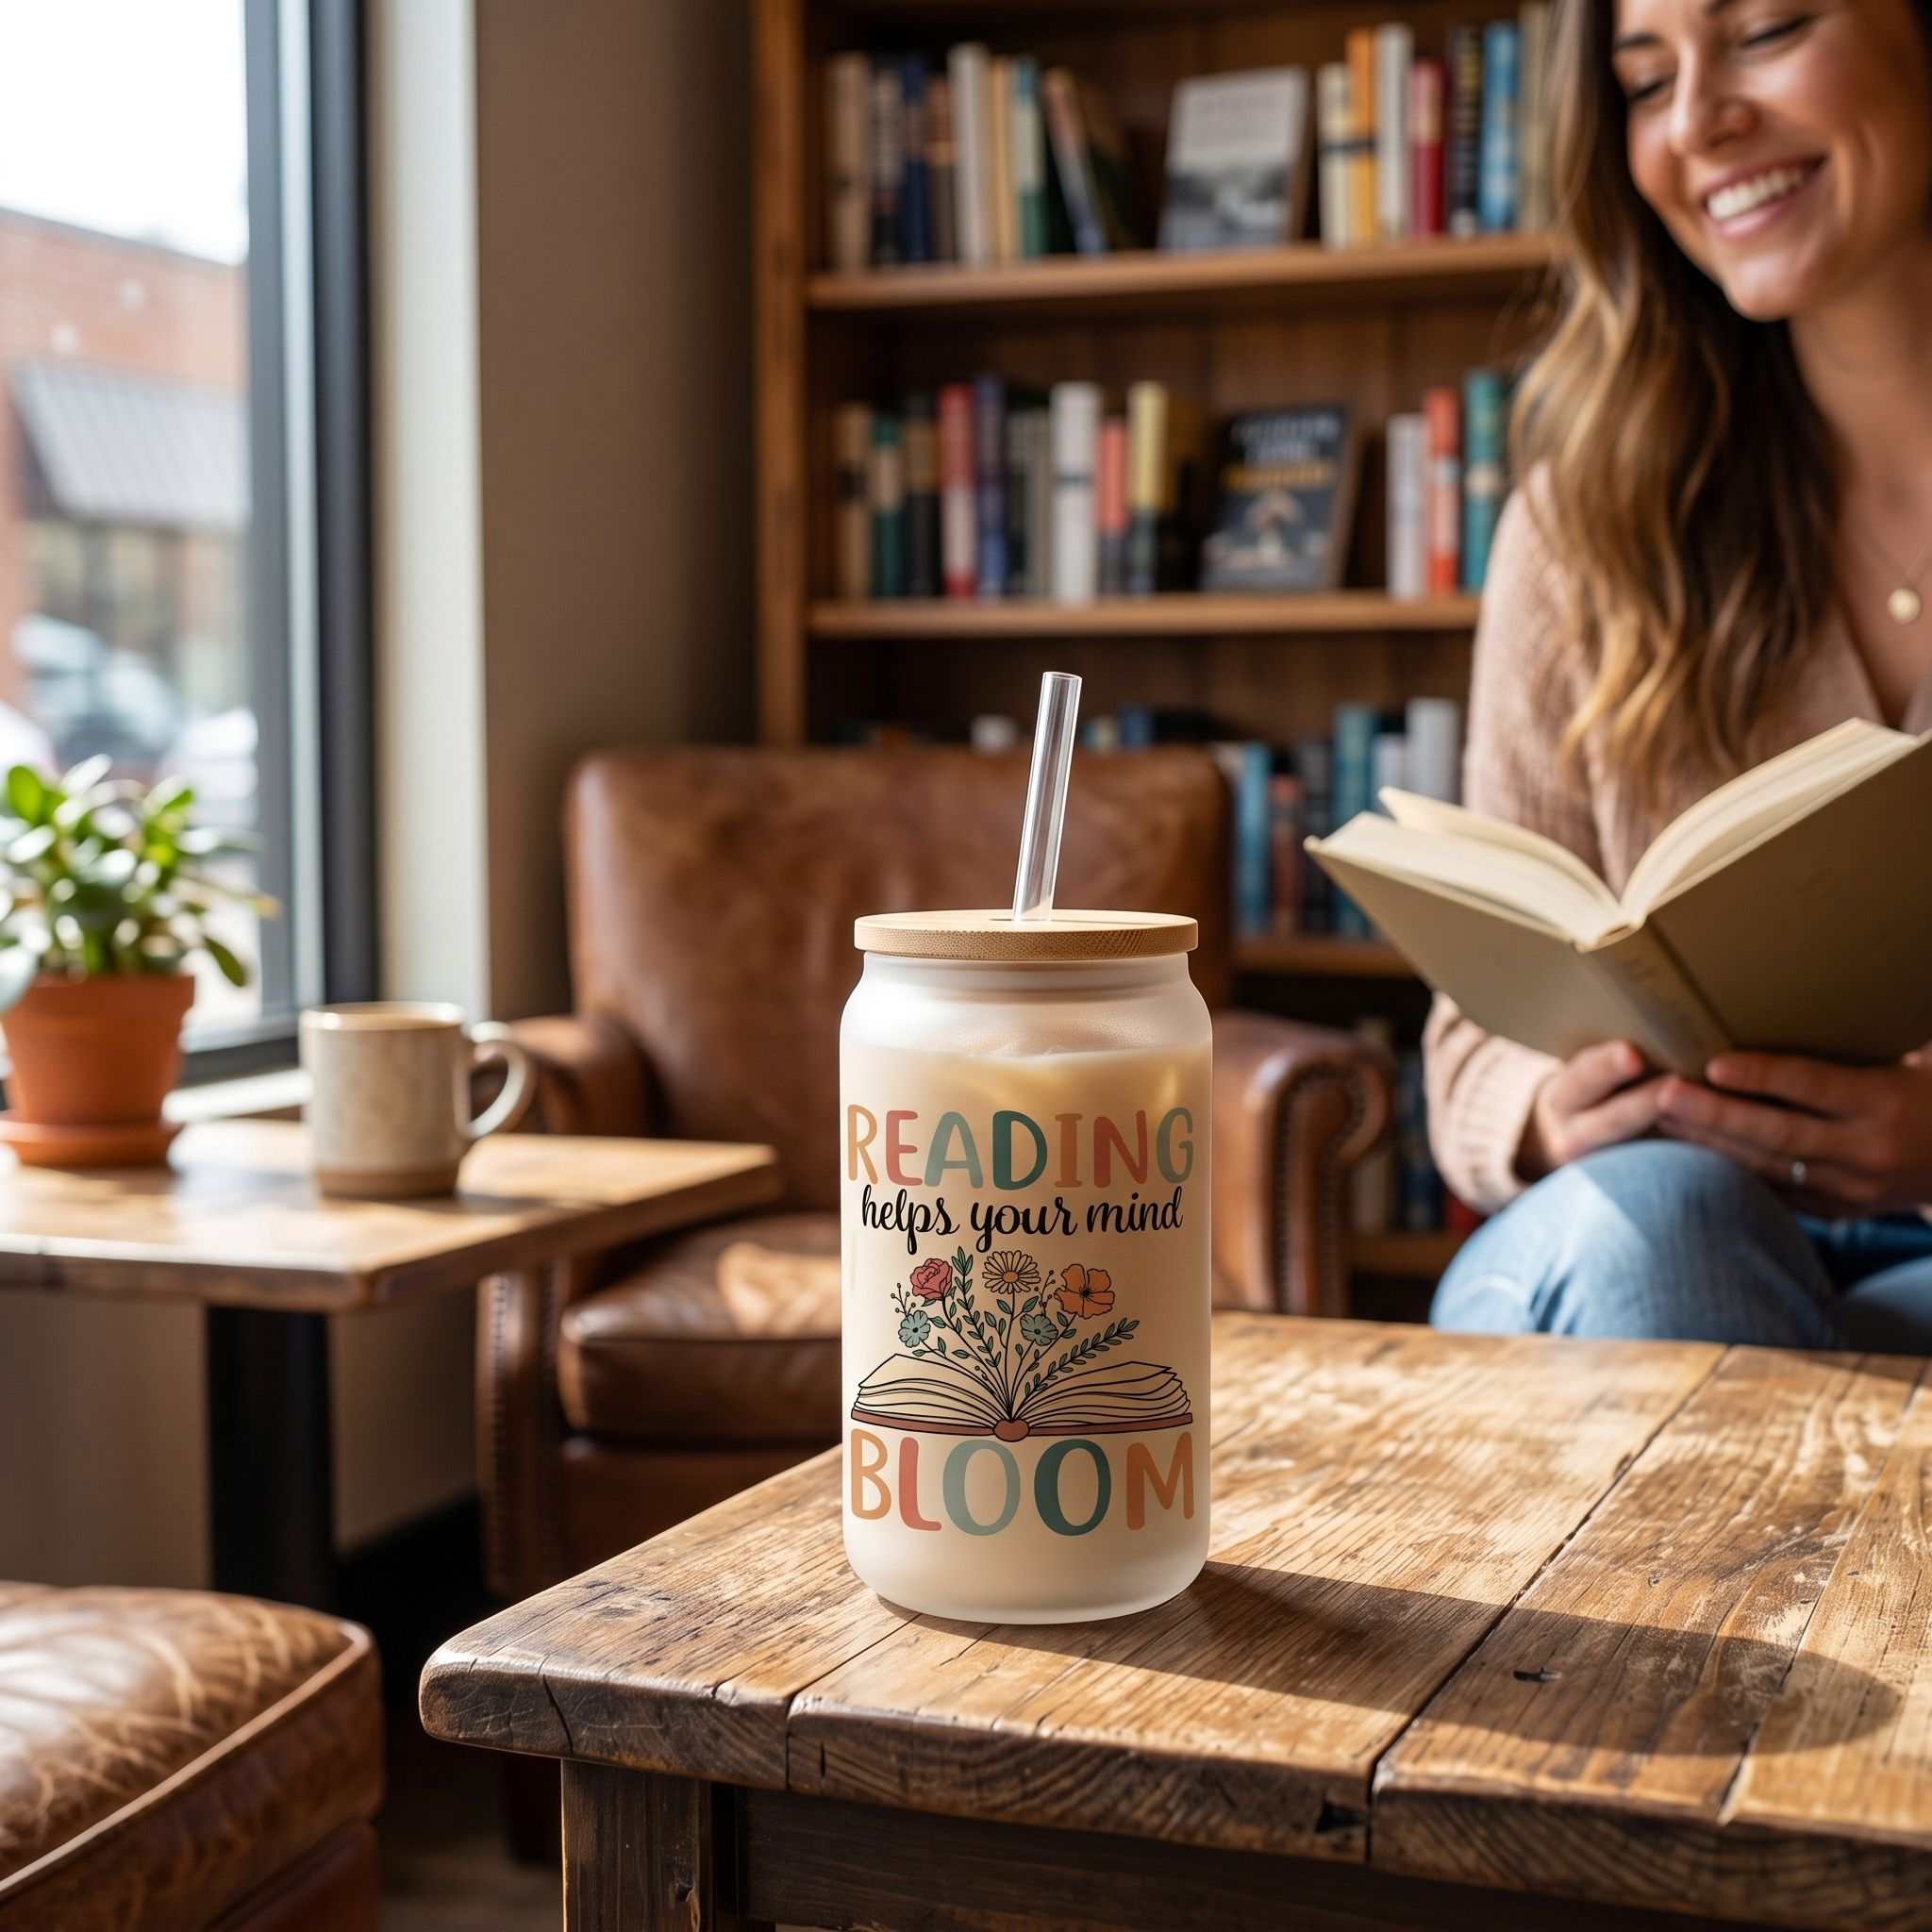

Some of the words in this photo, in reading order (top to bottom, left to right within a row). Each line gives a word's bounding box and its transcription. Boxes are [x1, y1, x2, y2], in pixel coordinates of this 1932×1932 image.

[847, 1104, 1194, 1191] READING
[861, 1184, 959, 1255] helps
[970, 1196, 1077, 1253] your
[1086, 1186, 1184, 1233] mind
[850, 1428, 1194, 1537] BLOOM
